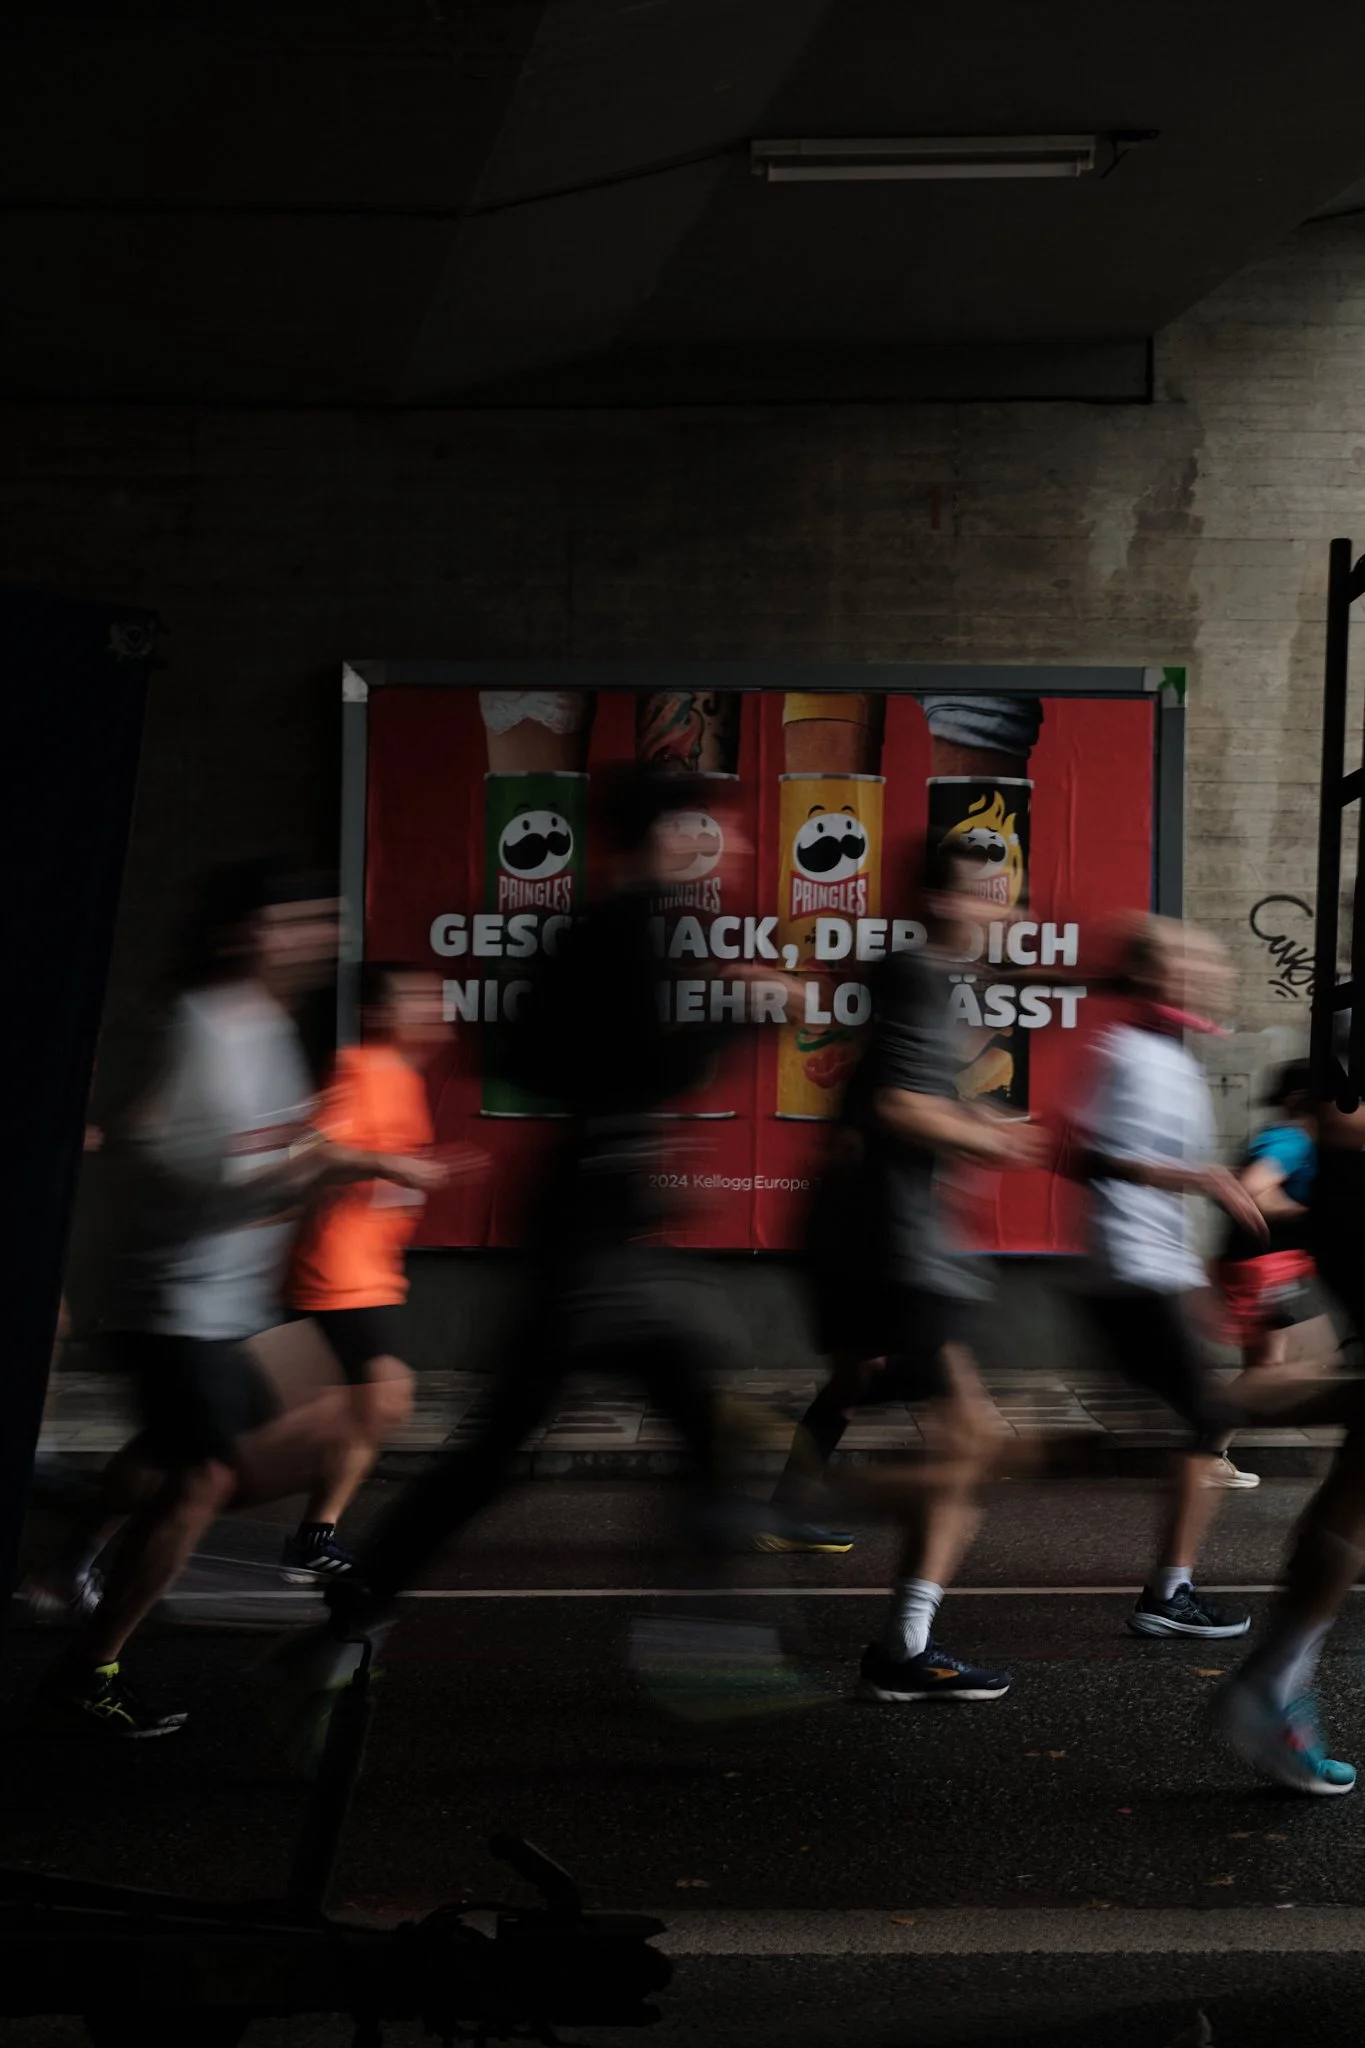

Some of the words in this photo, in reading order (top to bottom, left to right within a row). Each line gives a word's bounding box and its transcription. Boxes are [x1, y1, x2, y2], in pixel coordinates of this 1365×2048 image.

[498, 874, 573, 914] PRINGLES
[650, 876, 722, 914] INGLES
[791, 877, 867, 918] PRINGLES
[429, 912, 799, 969] GESCACK,
[804, 973, 1088, 1029] LOÄSST
[648, 1174, 689, 1189] 2024
[692, 1174, 751, 1191] Kellogg
[754, 1174, 810, 1193] Europe
